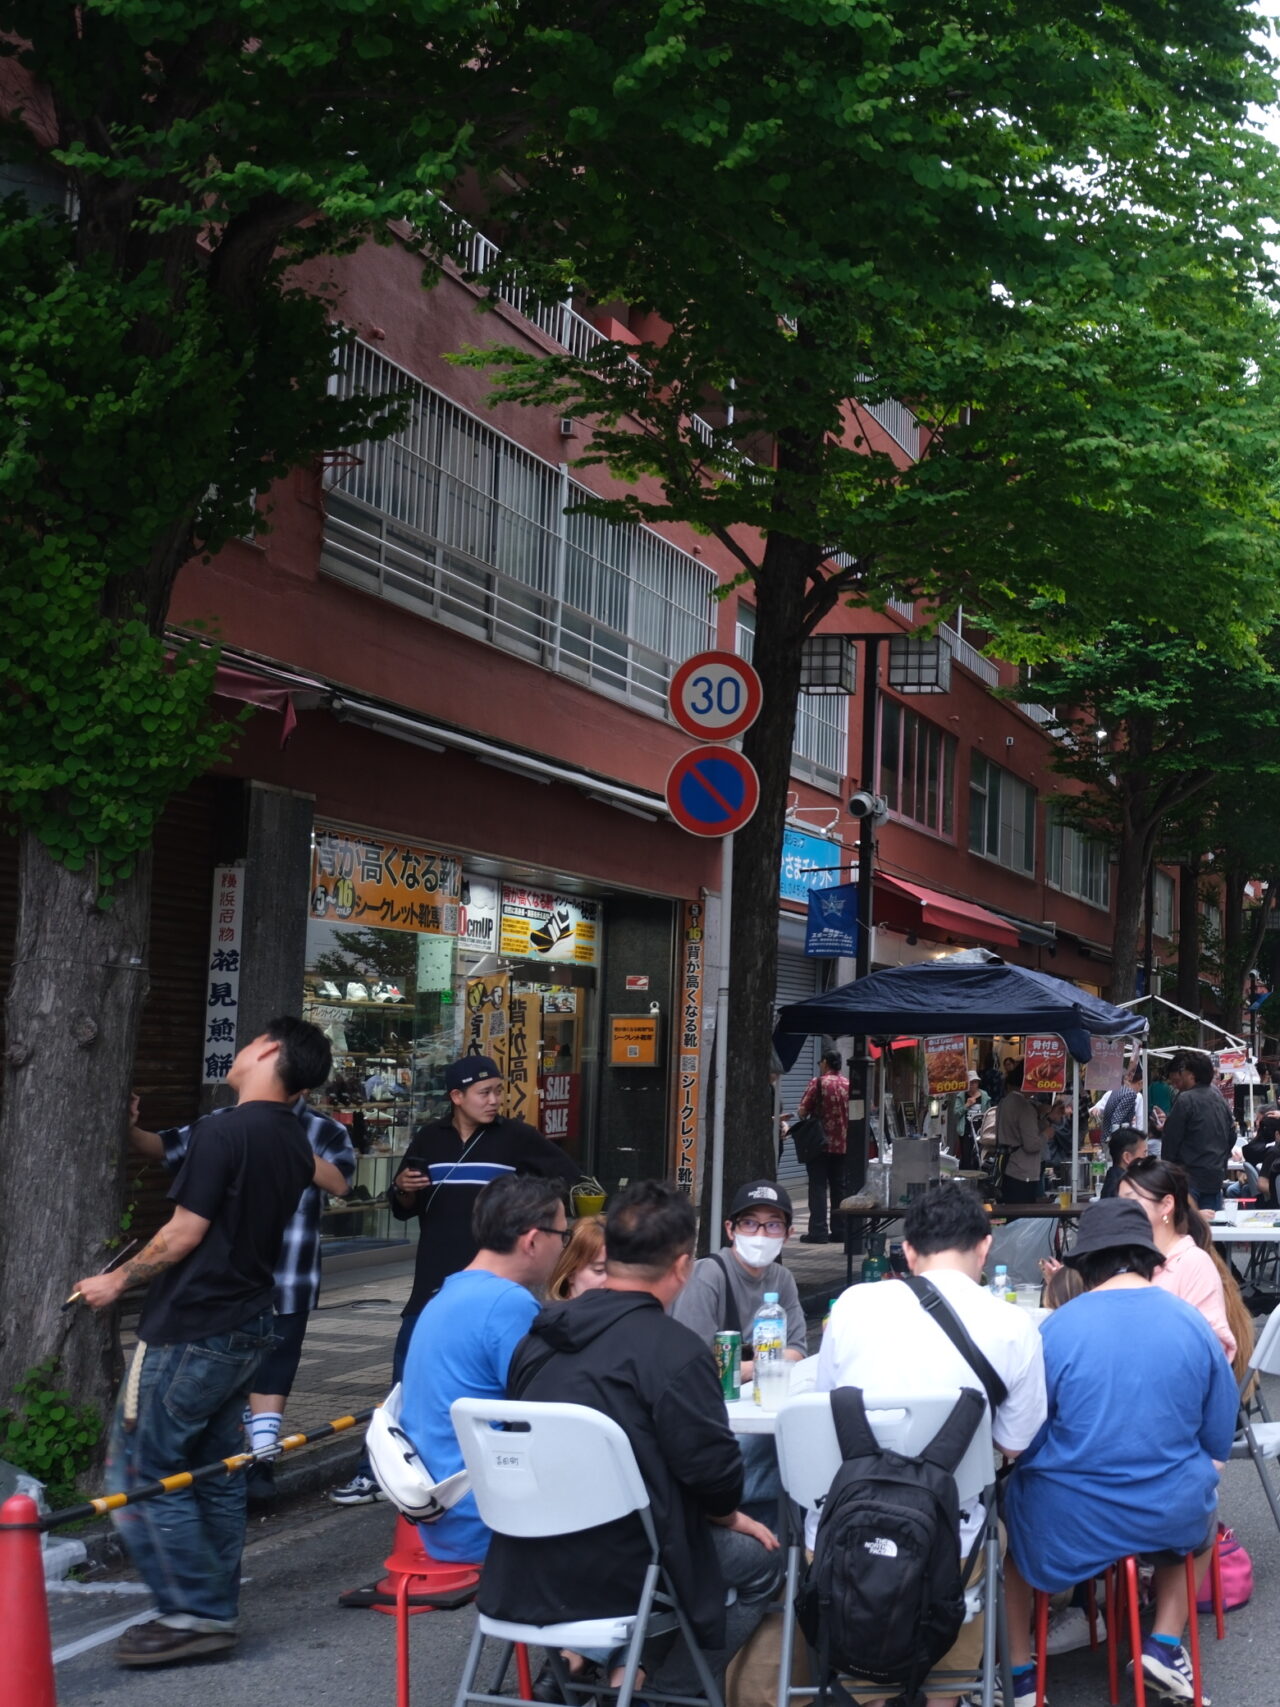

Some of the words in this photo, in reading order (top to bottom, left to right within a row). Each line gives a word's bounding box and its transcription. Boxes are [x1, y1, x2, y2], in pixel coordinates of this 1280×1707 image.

[690, 677, 741, 715] 30
[315, 830, 460, 897] 背が高くなる靴
[683, 945, 701, 1048] 背が高くなる靴
[1027, 1050, 1064, 1059] ソーセージ
[1032, 1041, 1058, 1049] 骨付き
[546, 1076, 570, 1101] SALE
[545, 1108, 568, 1134] SALE
